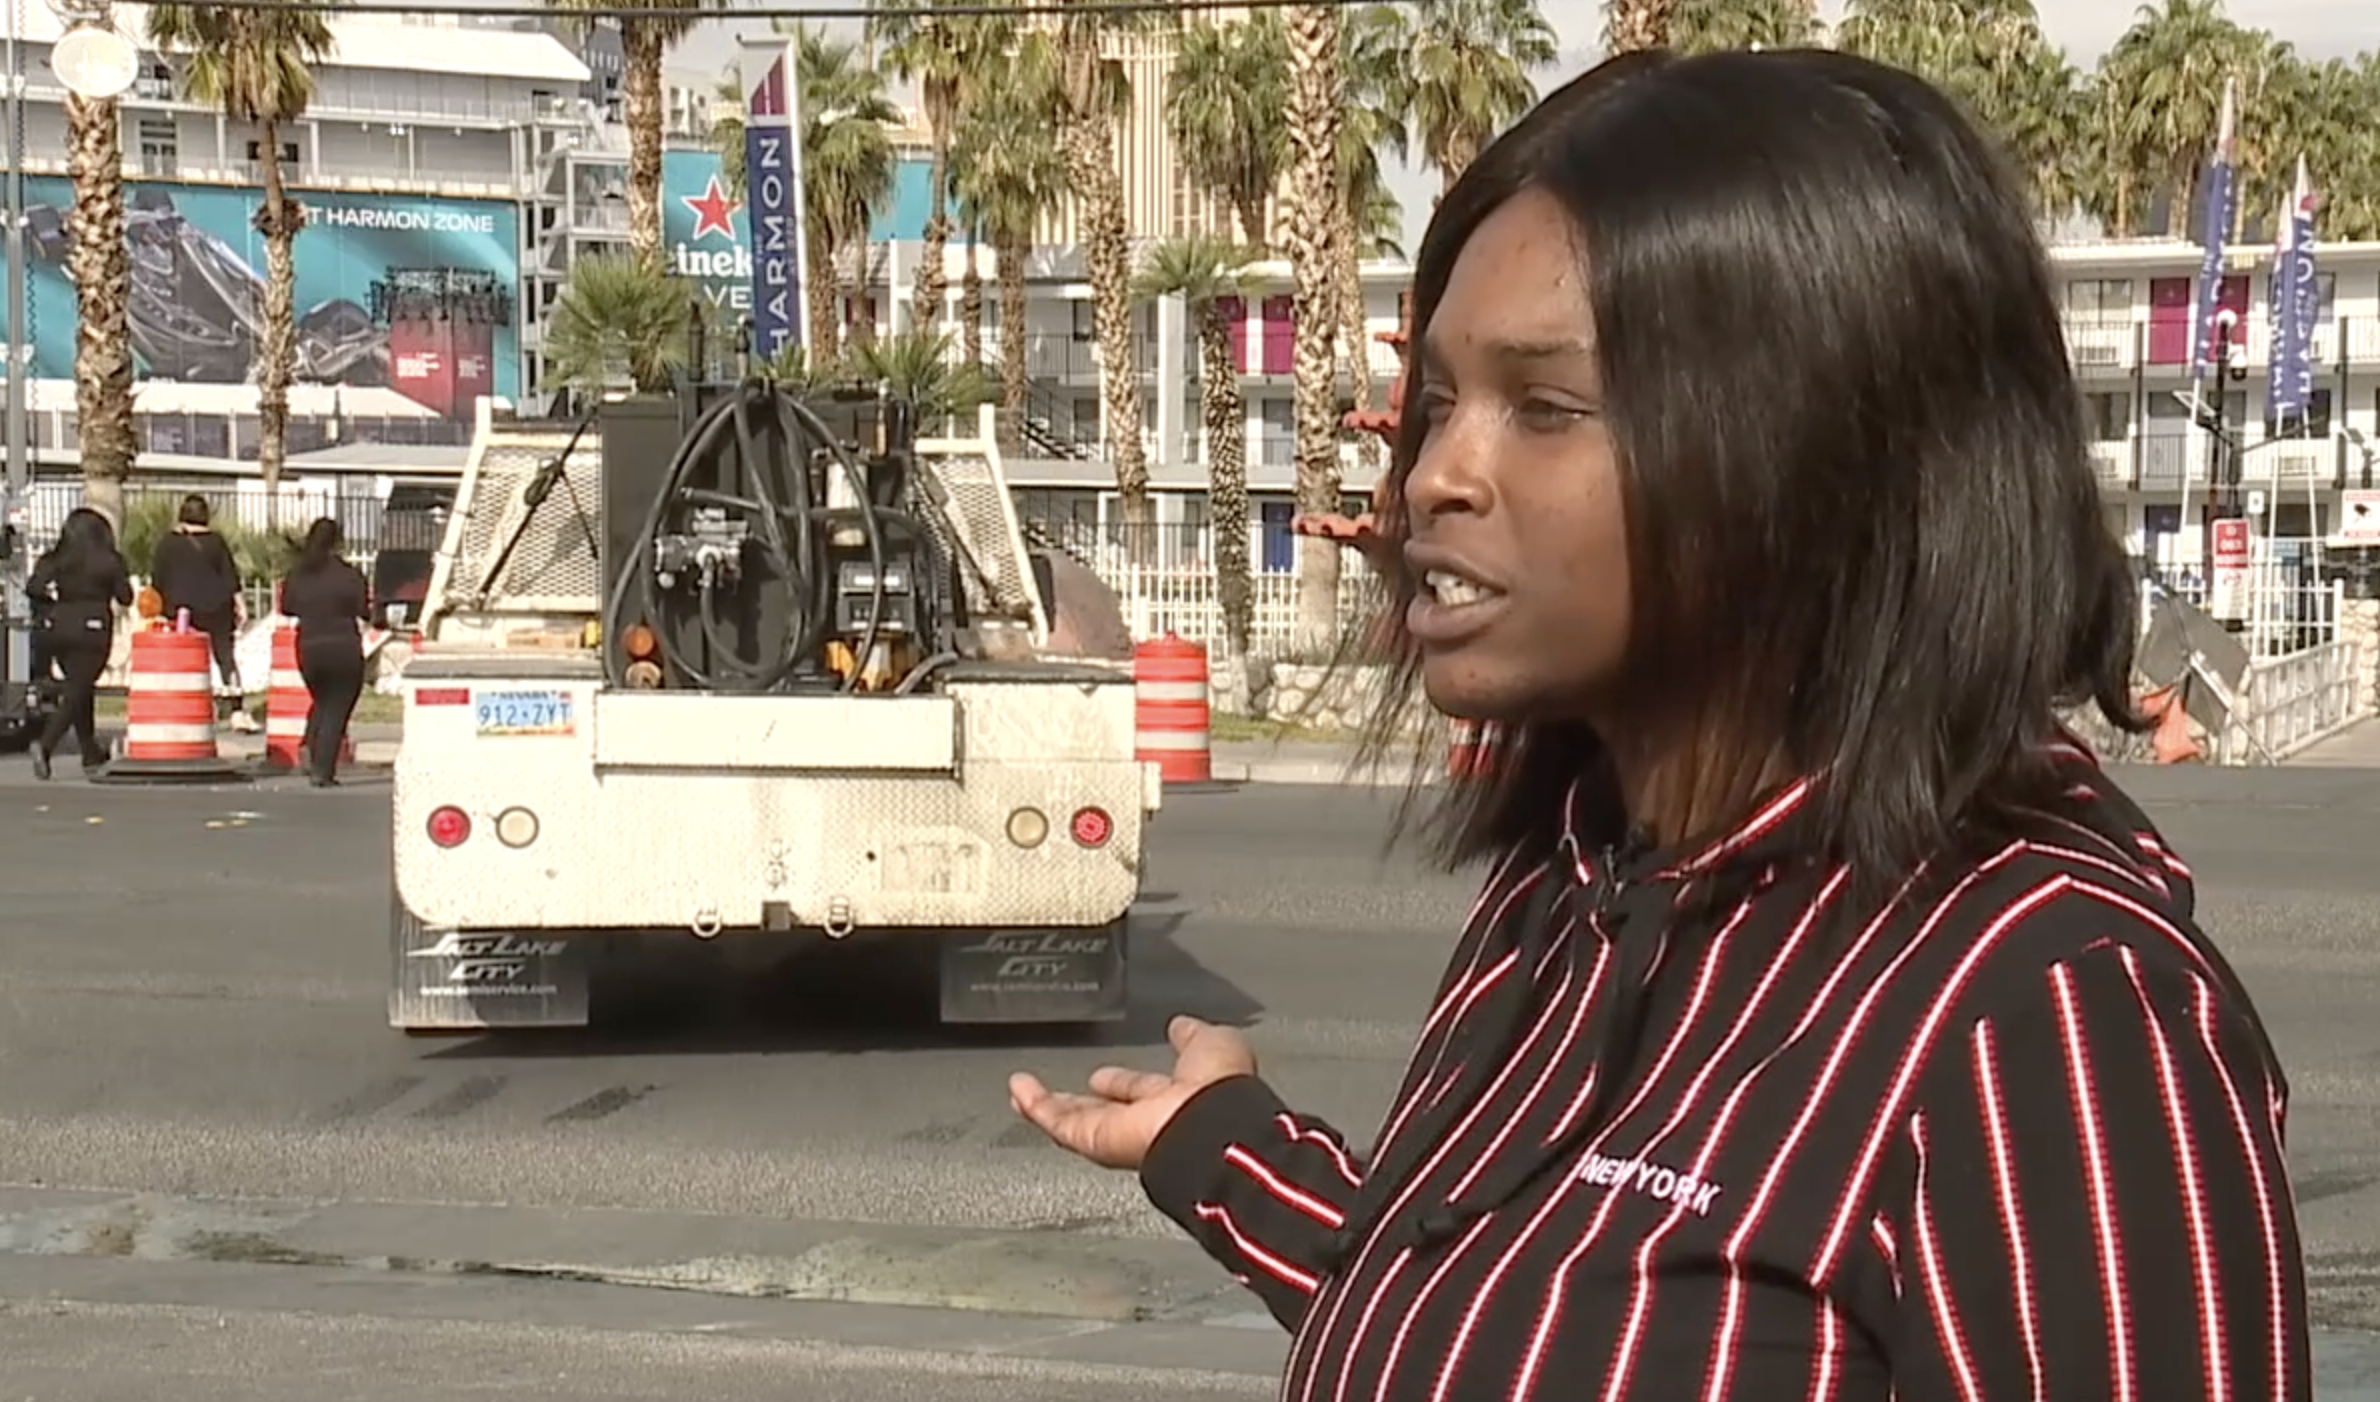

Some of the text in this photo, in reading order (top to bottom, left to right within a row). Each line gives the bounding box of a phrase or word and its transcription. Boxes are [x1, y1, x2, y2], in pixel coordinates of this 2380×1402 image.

[326, 207, 430, 231] HARMON
[434, 213, 494, 232] ZONE
[759, 138, 788, 356] HARMON
[407, 932, 568, 957] SALT LAKE
[1037, 931, 1109, 953] LAKE
[450, 957, 526, 980] CITY
[998, 955, 1067, 977] CITY
[1580, 1153, 1721, 1217] NEW YORK
